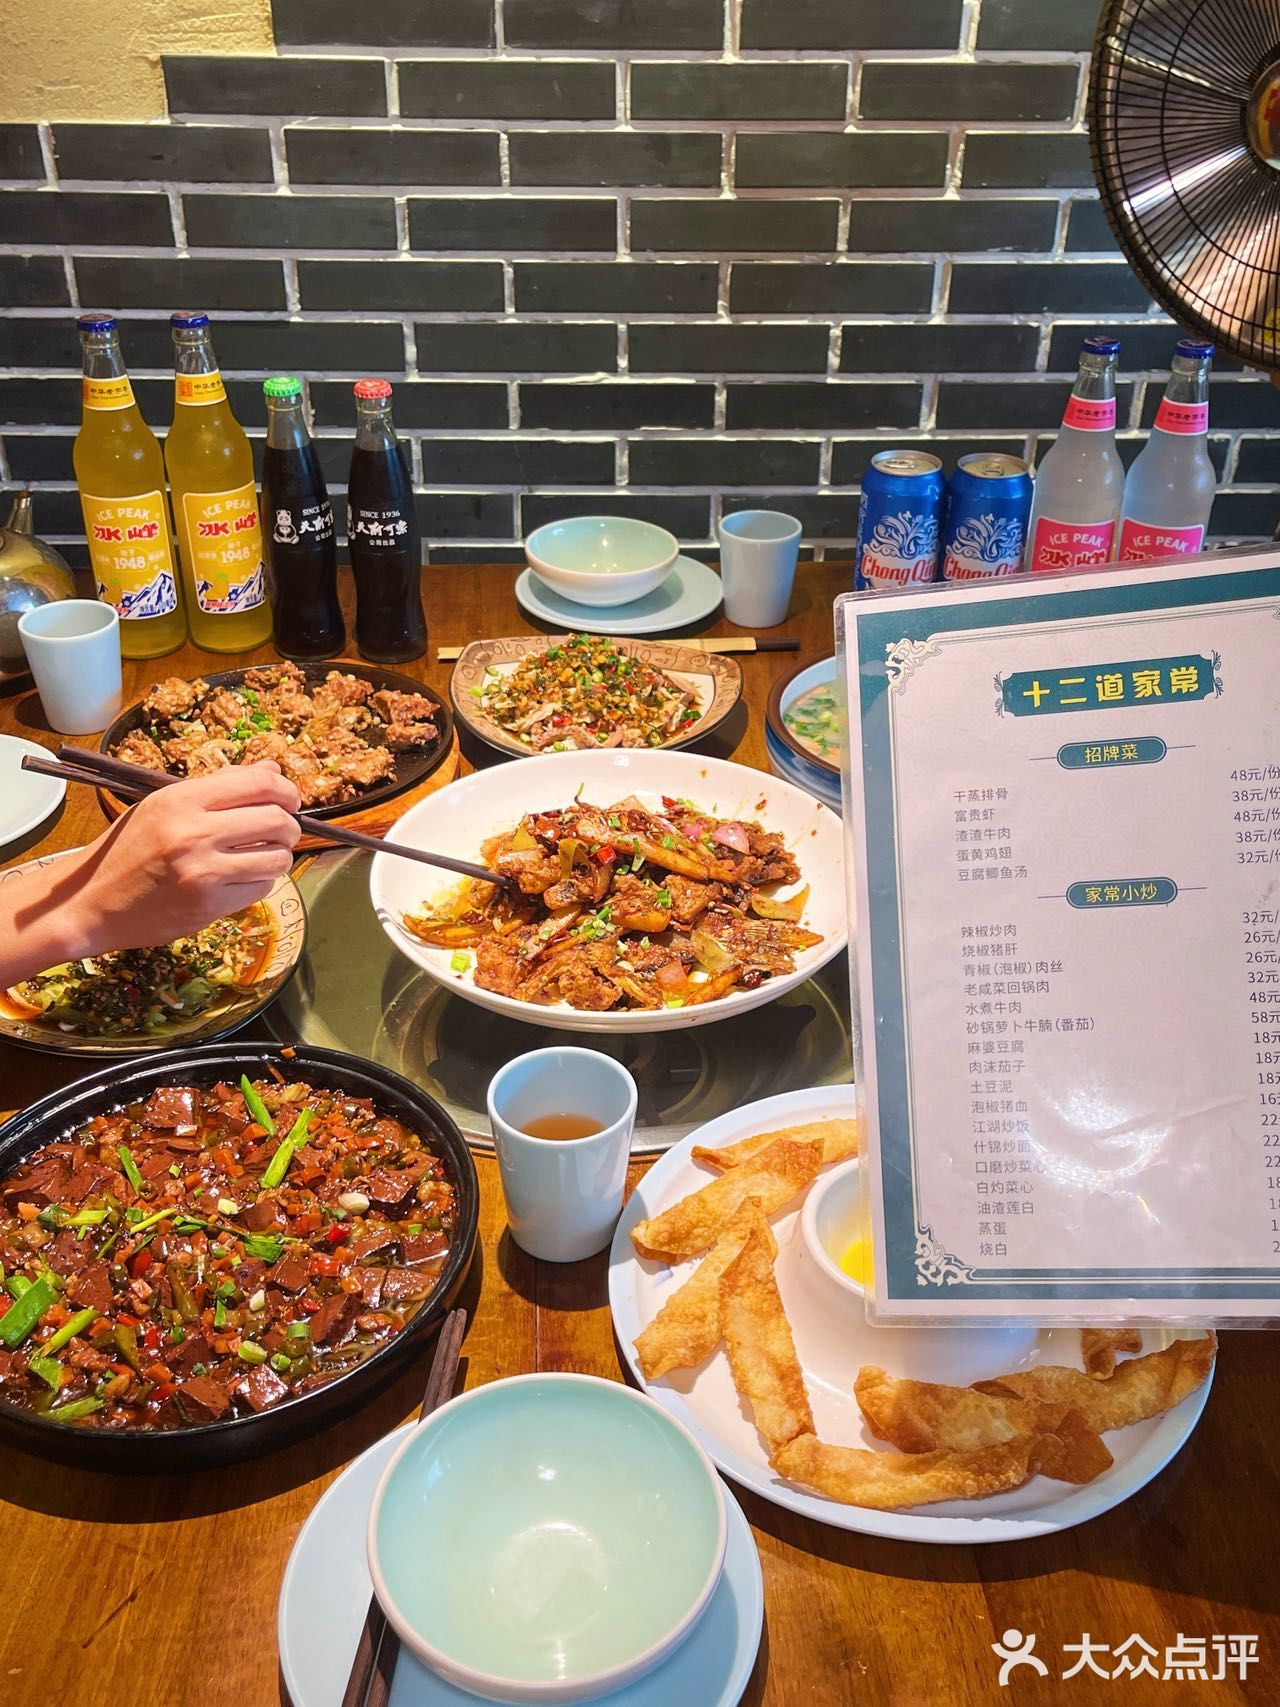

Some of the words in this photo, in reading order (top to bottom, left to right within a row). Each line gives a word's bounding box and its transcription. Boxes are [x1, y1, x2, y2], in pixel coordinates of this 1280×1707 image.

[96, 509, 114, 521] ICE
[117, 508, 150, 520] PEAK
[202, 504, 222, 518] ICE
[302, 506, 320, 516] SINCE
[360, 510, 380, 519] SINCE
[382, 511, 400, 519] 1936
[93, 523, 159, 541] 冰峰
[1050, 533, 1068, 546] ICE
[1073, 533, 1105, 548] PEAK
[1133, 535, 1151, 548] ICE
[1155, 536, 1189, 552] PEAK
[221, 546, 250, 564] 1948
[113, 556, 146, 570] 1948
[1023, 666, 1200, 708] 十二道家常
[1084, 743, 1139, 763] 招牌菜
[953, 788, 1008, 803] 干蒸排骨
[954, 808, 996, 822] 富贵虾
[955, 827, 1011, 842] 渣渣牛肉
[956, 846, 1012, 862] 蛋黄鸡翅
[958, 865, 1028, 881] 豆腐鲫鱼汤
[1085, 883, 1158, 903] 家常小炒
[960, 924, 1017, 938] 辣椒炒肉
[962, 943, 1018, 957] 烧椒猪肝
[964, 980, 1050, 996] 老咸菜回锅肉
[1249, 991, 1280, 1003] 48元
[965, 1001, 1022, 1015] 水煮牛肉
[967, 1040, 1024, 1054] 麻婆豆腐
[969, 1060, 1026, 1074] 肉沫茄子
[971, 1080, 1013, 1094] 土豆泥
[1260, 1093, 1280, 1105] 16
[972, 1100, 1028, 1113] 泡椒猪血
[972, 1120, 1030, 1134] 江湖炒饭
[974, 1140, 1031, 1154] 什锦炒面
[977, 1181, 1034, 1195] 白灼菜心
[977, 1202, 1035, 1215] 油渣莲白
[978, 1222, 1007, 1236] 蒸蛋
[979, 1242, 1008, 1256] 烧白
